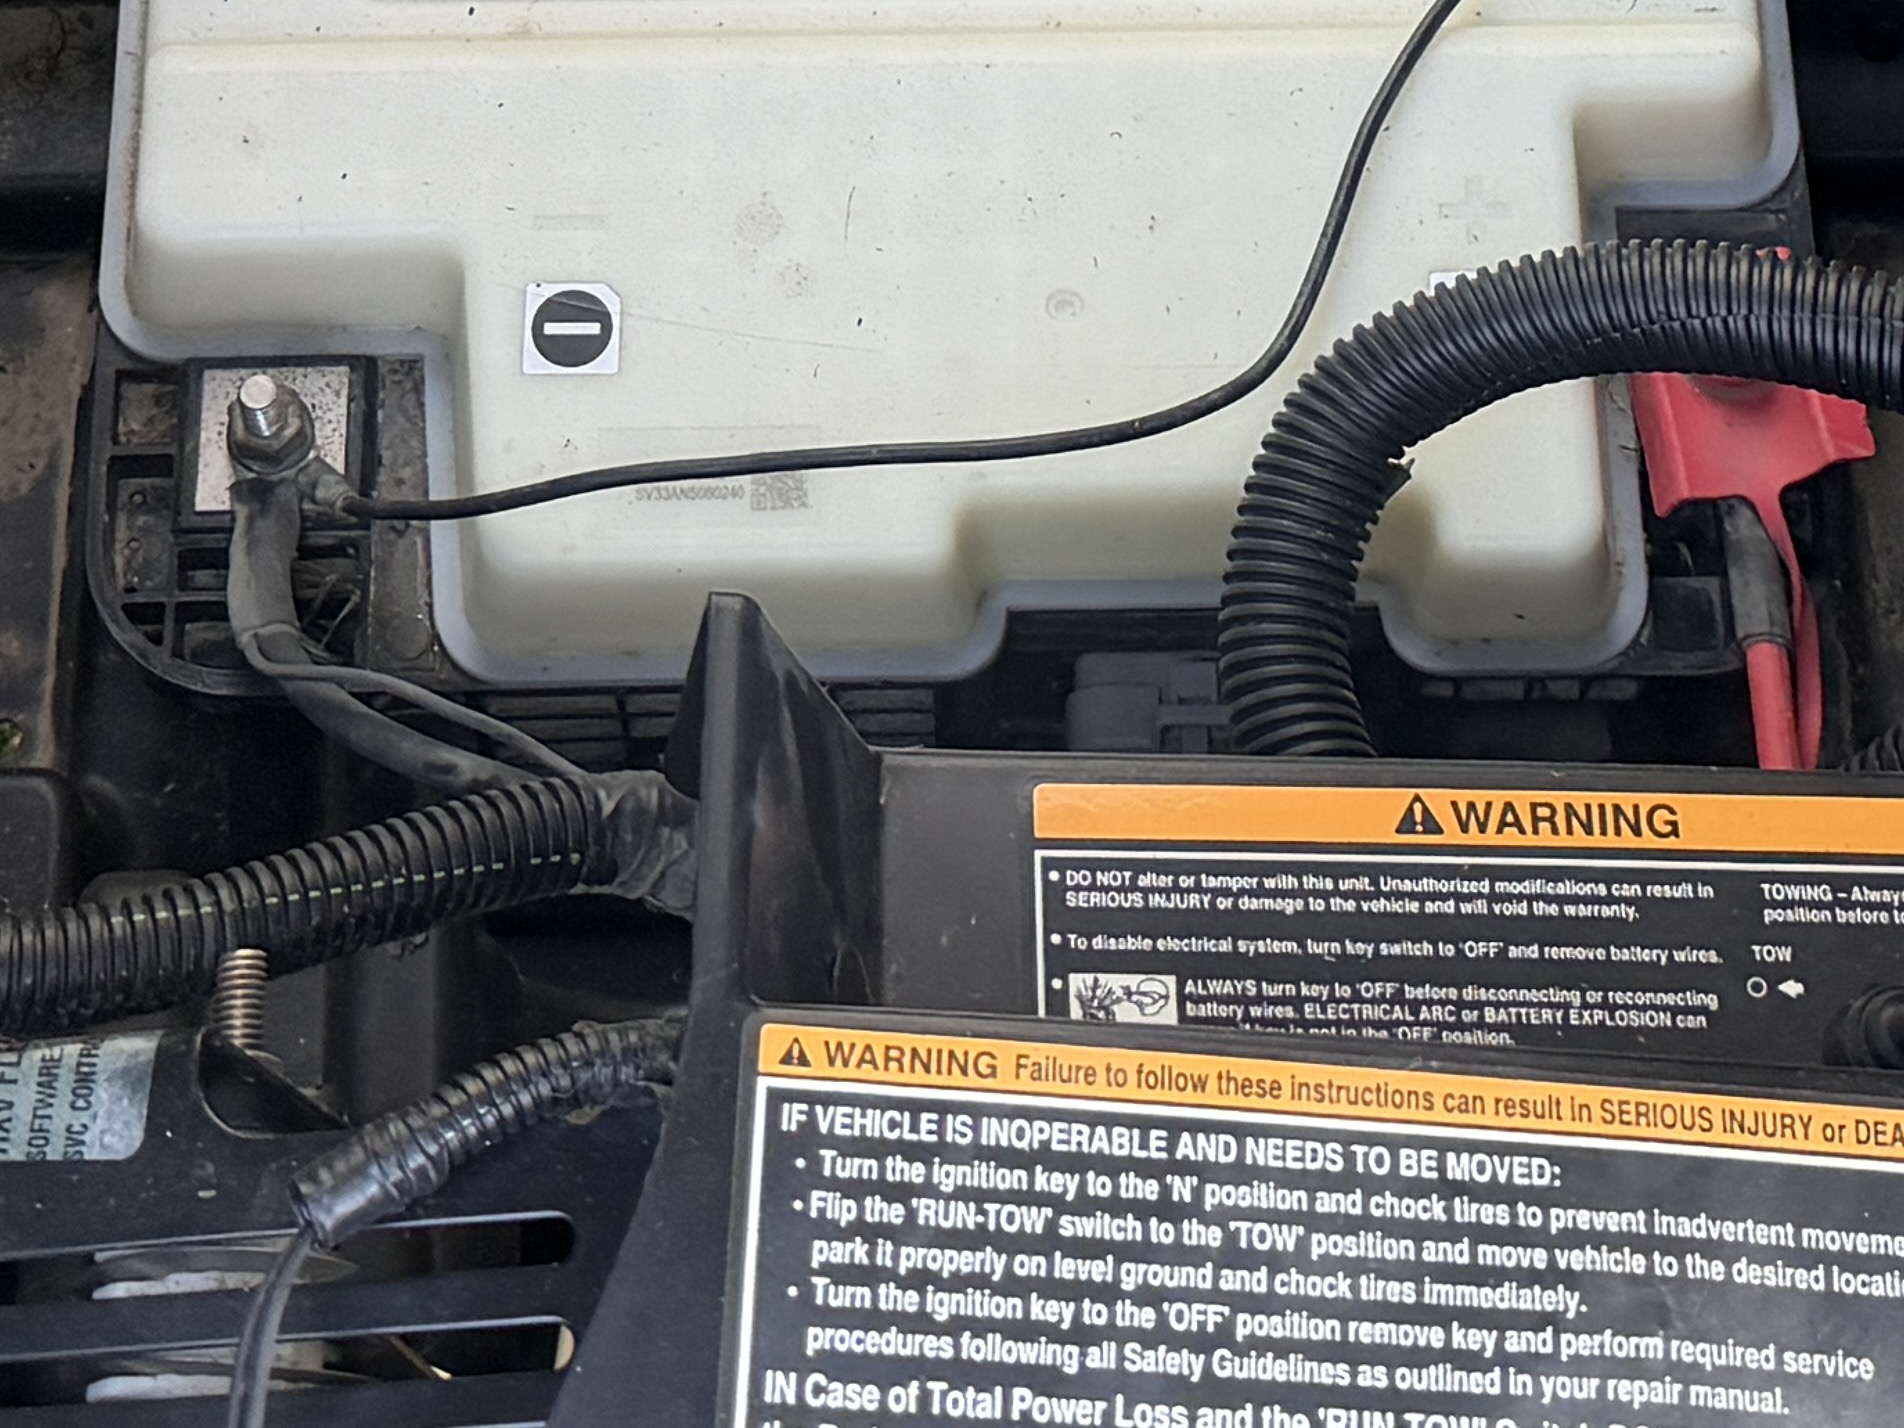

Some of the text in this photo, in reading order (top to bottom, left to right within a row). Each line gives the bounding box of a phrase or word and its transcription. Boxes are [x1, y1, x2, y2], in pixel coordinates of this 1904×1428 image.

[1450, 801, 1680, 838] WARNING
[1066, 870, 1714, 898] DO NOT alter or tamper with this unit. Unauthorized modifications can result in
[1066, 891, 1639, 921] SERIOUS INJURY or damage to the vehicle and will void the warranty.
[1760, 883, 1832, 901] TOWING
[1764, 907, 1832, 924] position
[1836, 907, 1889, 924] before
[1751, 945, 1792, 962] TOW
[26, 1047, 63, 1159] SOFTWARE
[824, 1040, 997, 1079] WARNING
[1015, 1054, 1096, 1086] Failure
[1106, 1063, 1127, 1087] to
[1136, 1063, 1208, 1093] follow
[1217, 1070, 1282, 1099] these
[1291, 1074, 1434, 1111] instructions
[1443, 1093, 1485, 1114] can
[1494, 1094, 1562, 1121] result
[1571, 1096, 1592, 1122] in
[1600, 1099, 1713, 1132] SERIOUS
[1722, 1108, 1812, 1140] INJURY
[1822, 1123, 1846, 1143] or
[63, 1123, 88, 1159] SVC
[781, 1103, 808, 1132] IF
[815, 1105, 938, 1142] VEHICLE
[946, 1114, 973, 1145] IS
[1176, 1132, 1237, 1163] AND
[1246, 1137, 1344, 1172] NEEDS
[1350, 1144, 1390, 1175] TO
[1400, 1148, 1438, 1179] BE
[1447, 1152, 1561, 1187] MOVED:
[818, 1149, 878, 1180] Turn
[885, 1155, 926, 1183] the
[933, 1157, 1028, 1192] ignition
[1035, 1165, 1080, 1201] key
[1086, 1170, 1112, 1197] to
[1119, 1172, 1160, 1201] the
[1166, 1174, 1198, 1202] 'N'
[1204, 1180, 1308, 1211] position
[1315, 1188, 1362, 1215] and
[1370, 1191, 1447, 1221] chock
[1454, 1196, 1510, 1226] tires
[1517, 1202, 1542, 1227] to
[1550, 1208, 1647, 1234] prevent
[1654, 1208, 1795, 1247] inadvertent
[809, 1190, 857, 1227] Flip
[864, 1195, 905, 1224] the
[912, 1198, 1052, 1234] 'RUN-TOW'
[1058, 1211, 1142, 1241] switch
[1150, 1217, 1175, 1244] to
[1182, 1218, 1222, 1247] the
[1229, 1221, 1304, 1252] 'TOW'
[1311, 1230, 1415, 1261] position
[1422, 1237, 1470, 1264] and
[1478, 1244, 1548, 1269] move
[1554, 1245, 1646, 1274] vehicle
[1653, 1251, 1678, 1277] to
[1685, 1252, 1725, 1281] the
[1732, 1257, 1825, 1291] desired
[811, 1237, 1588, 1319] park it properly on level ground and chock tires immediately.
[810, 1276, 1874, 1381] Turn the ignition key to the 'OFF' position remove key and perform required service
[806, 1326, 1790, 1415] procedures following all Safety Guidelines as outlined in your repair manual.
